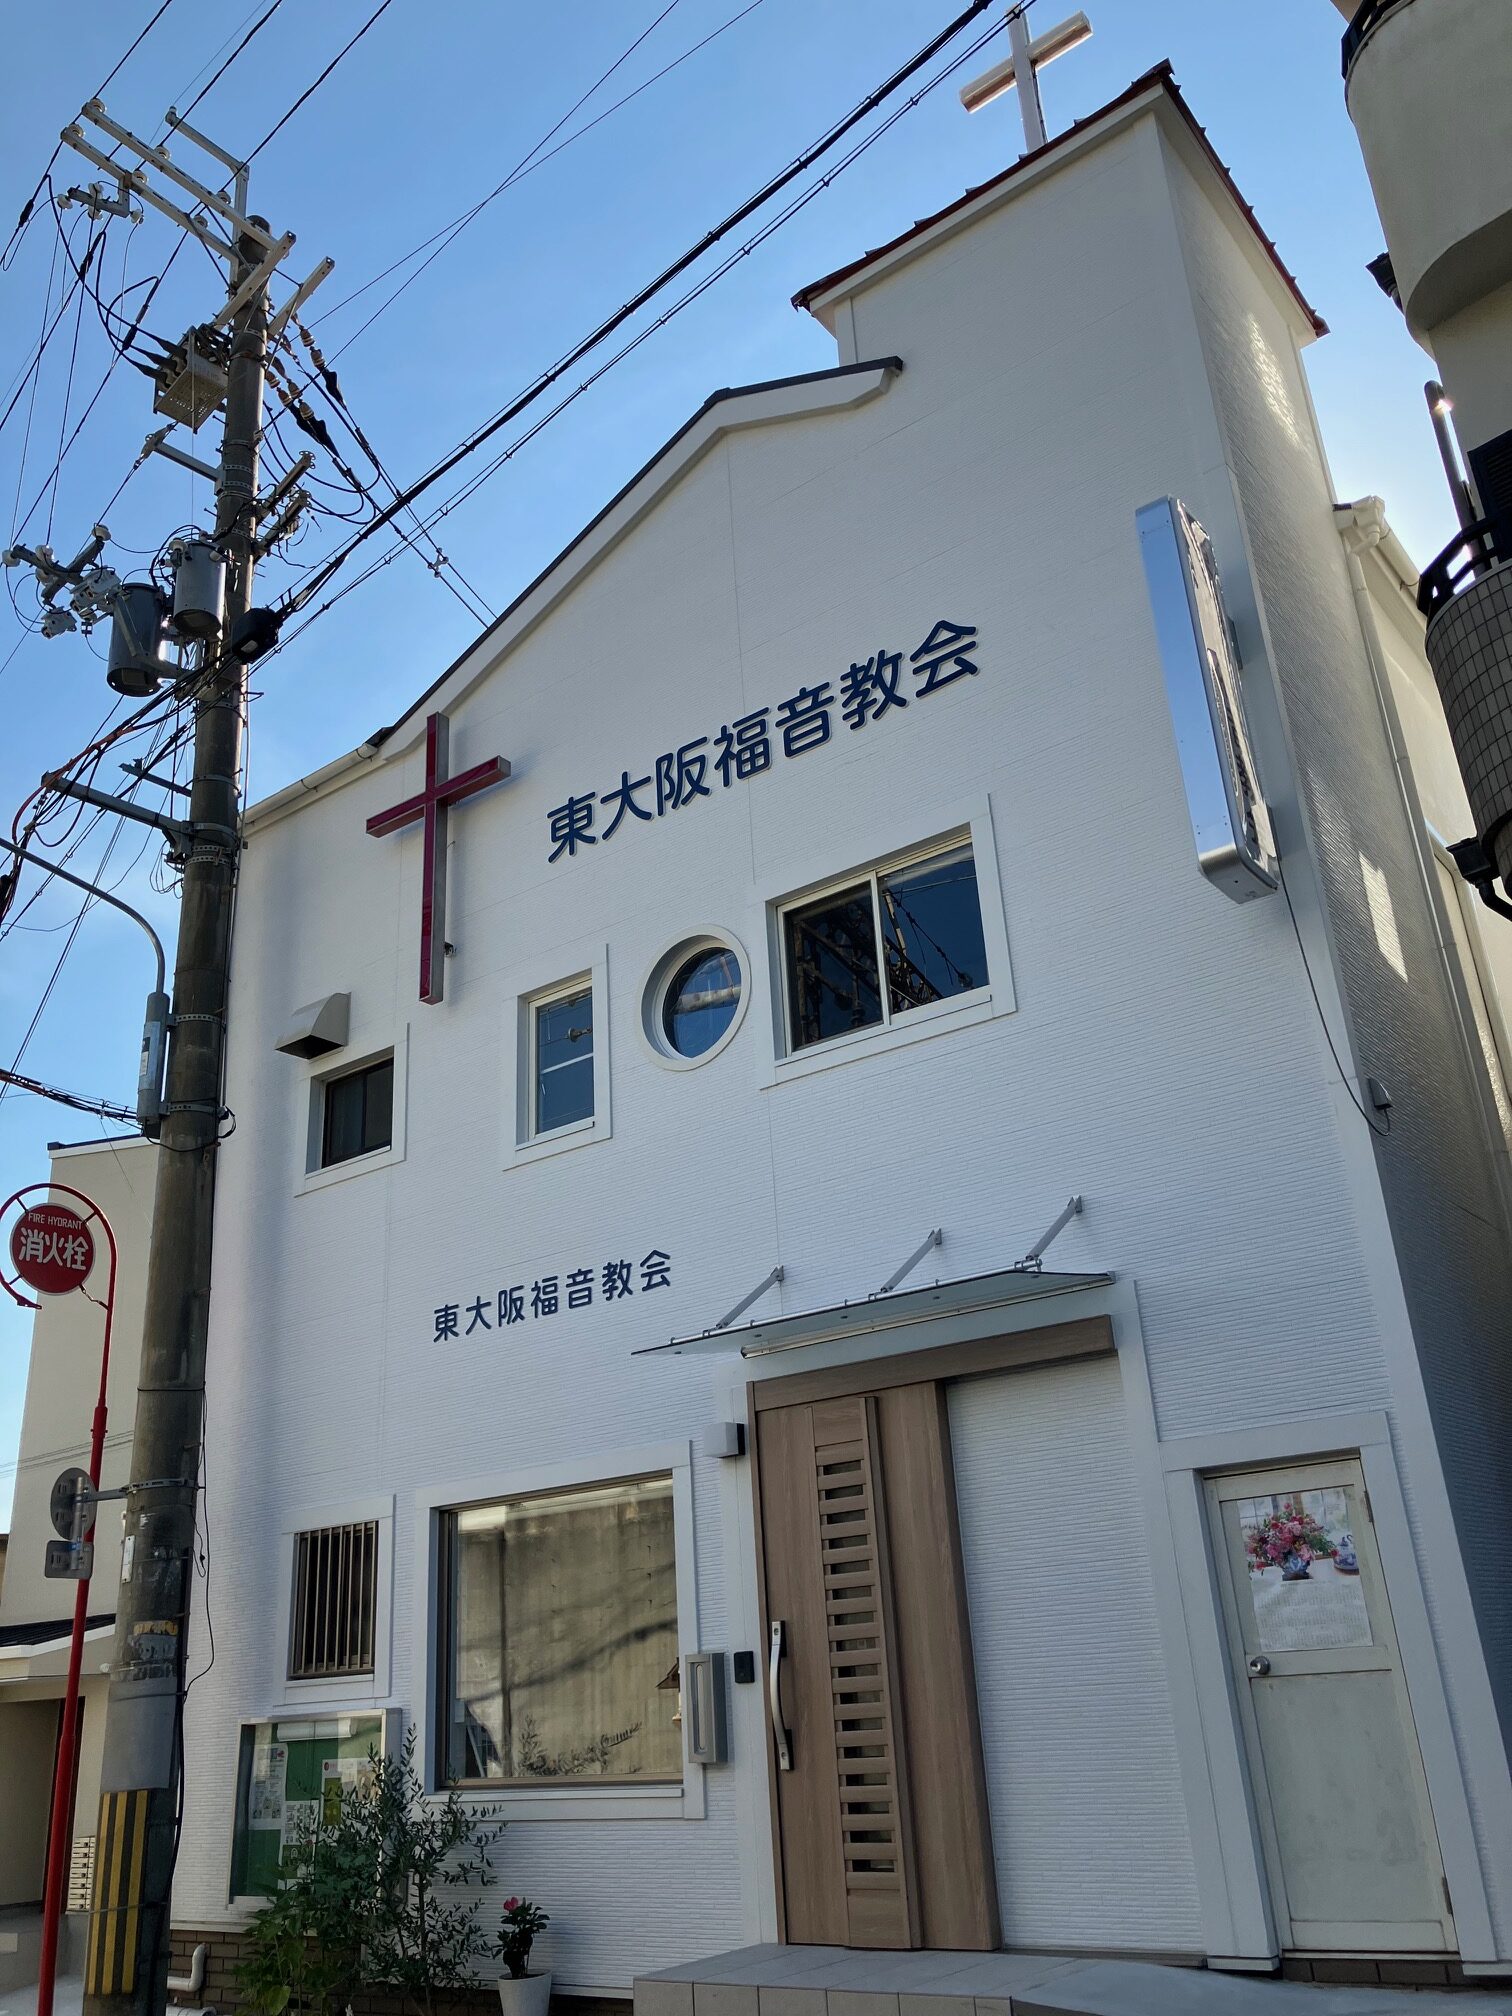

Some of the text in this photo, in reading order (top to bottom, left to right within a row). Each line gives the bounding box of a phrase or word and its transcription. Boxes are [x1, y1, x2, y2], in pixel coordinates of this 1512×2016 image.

[547, 619, 978, 863] 東大阪福音教会
[19, 1227, 88, 1270] 消火栓
[28, 1213, 82, 1229] FIRE HYDRANT
[433, 1249, 671, 1343] 東大阪福音教会
